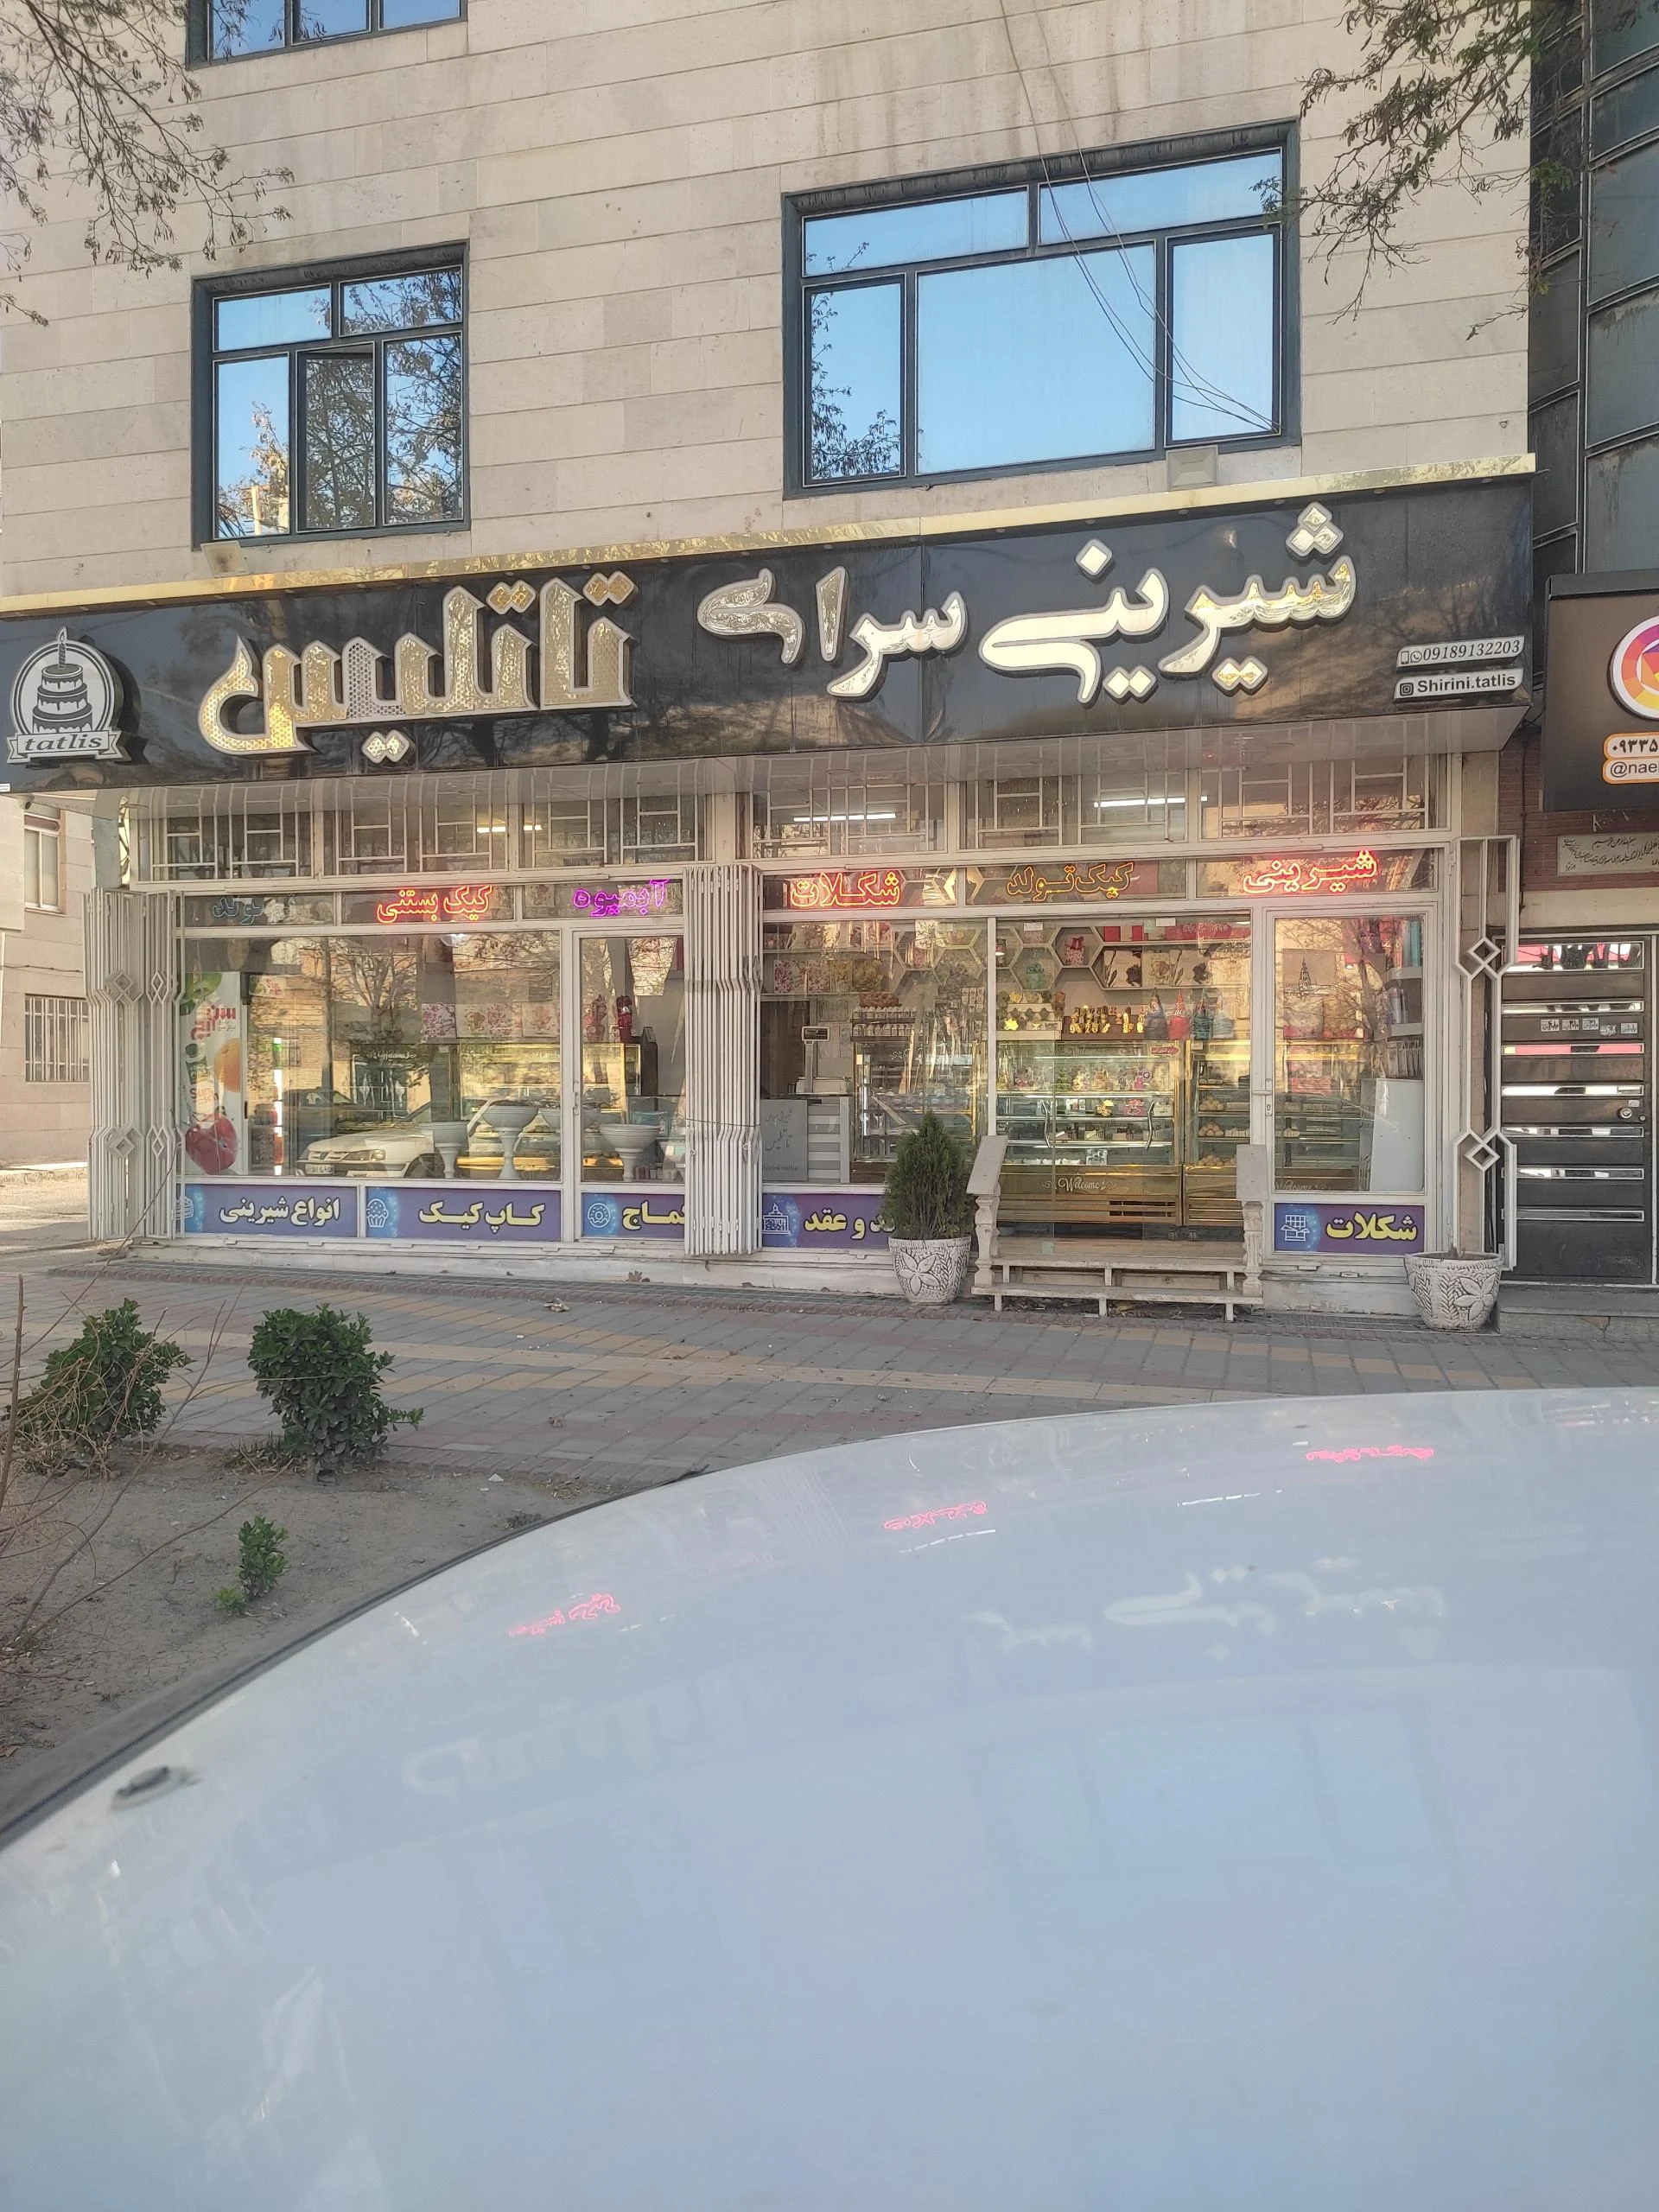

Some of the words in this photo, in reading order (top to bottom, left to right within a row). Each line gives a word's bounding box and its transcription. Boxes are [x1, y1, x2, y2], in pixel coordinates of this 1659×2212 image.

[979, 501, 1357, 706] شیرینی
[696, 564, 967, 698] سرای
[1422, 639, 1520, 661] 09189132203
[1417, 673, 1516, 693] Shirini.tatlis
[24, 732, 104, 753] tatlis
[1610, 760, 1659, 778] @nae
[1007, 865, 1077, 902] تولد
[1076, 861, 1134, 898] کیک
[1243, 849, 1376, 894] شیرینی
[442, 885, 493, 921] کیک
[574, 879, 669, 918] آبمیوه
[790, 869, 901, 908] شکلات
[377, 887, 439, 923] بستنی
[1058, 1176, 1099, 1192] Welcome
[219, 1195, 289, 1225] شیرینی
[289, 1197, 341, 1227] انواع
[418, 1200, 485, 1230] کیک
[485, 1202, 545, 1234] کاپ
[622, 1199, 684, 1230] ماج
[804, 1208, 847, 1232] عقد
[851, 1217, 866, 1240] و
[1325, 1211, 1418, 1242] شکلات
